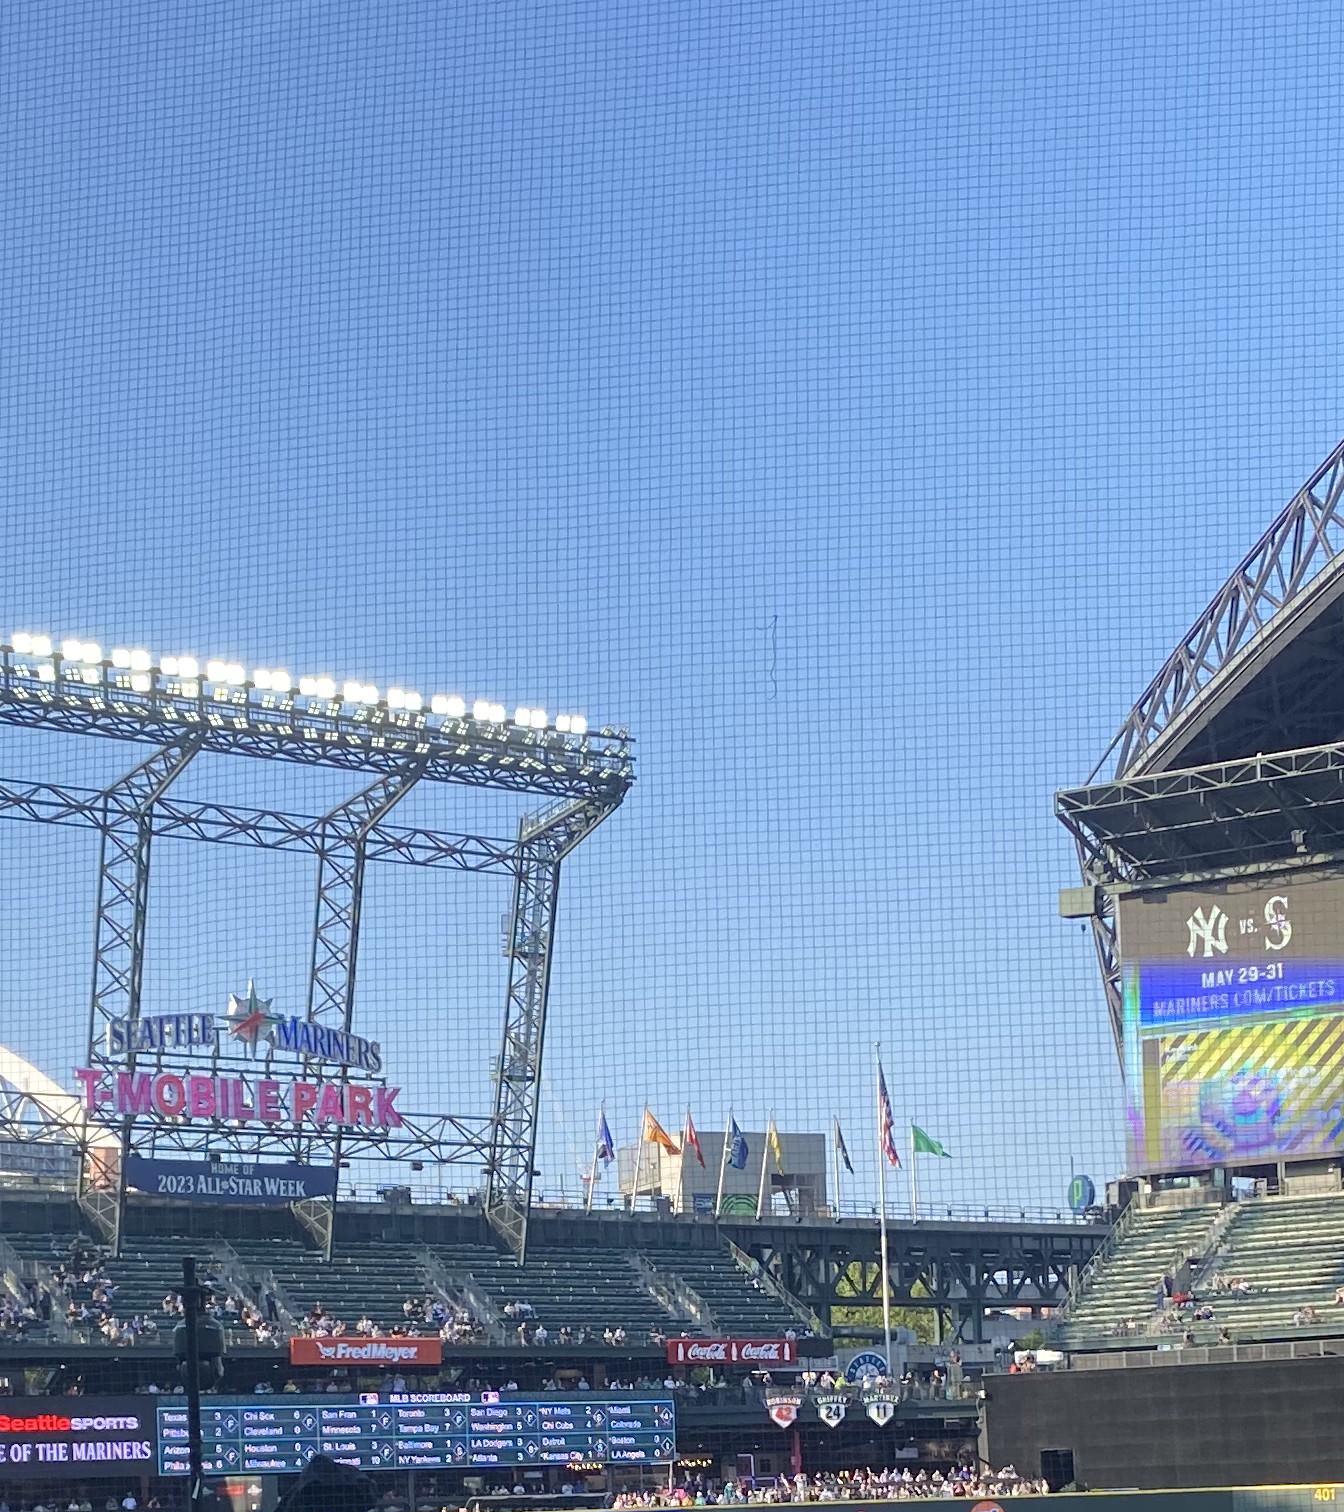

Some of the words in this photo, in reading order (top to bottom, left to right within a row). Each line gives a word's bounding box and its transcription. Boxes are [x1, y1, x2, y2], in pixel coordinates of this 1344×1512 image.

[1264, 896, 1292, 950] S
[1202, 970, 1233, 988] MAY
[1239, 963, 1284, 984] 29-31
[106, 1013, 215, 1056] SEATTLE
[273, 1014, 383, 1073] MARINERS
[75, 1067, 283, 1122] T-MOBILE
[290, 1080, 404, 1128] PARK
[211, 1162, 239, 1175] HOME
[243, 1162, 254, 1175] OF
[158, 1174, 194, 1193] 2023
[264, 1177, 307, 1198] WEEK
[390, 1394, 409, 1403] MLB
[410, 1393, 471, 1403] SCOREBOARD
[322, 1410, 337, 1419] San
[339, 1410, 357, 1418] Fran
[398, 1409, 425, 1417] Toronto
[471, 1408, 485, 1416] San
[486, 1408, 508, 1417] Diego
[826, 1406, 841, 1420] 24
[876, 1405, 886, 1418] 11
[71, 1416, 139, 1431] SPORTS
[322, 1425, 361, 1434] Minnesota
[244, 1427, 283, 1435] Cleveland
[10, 1443, 31, 1462] OF
[35, 1442, 68, 1462] THE
[72, 1440, 152, 1461] MARINERS
[1314, 1488, 1335, 1501] 401
